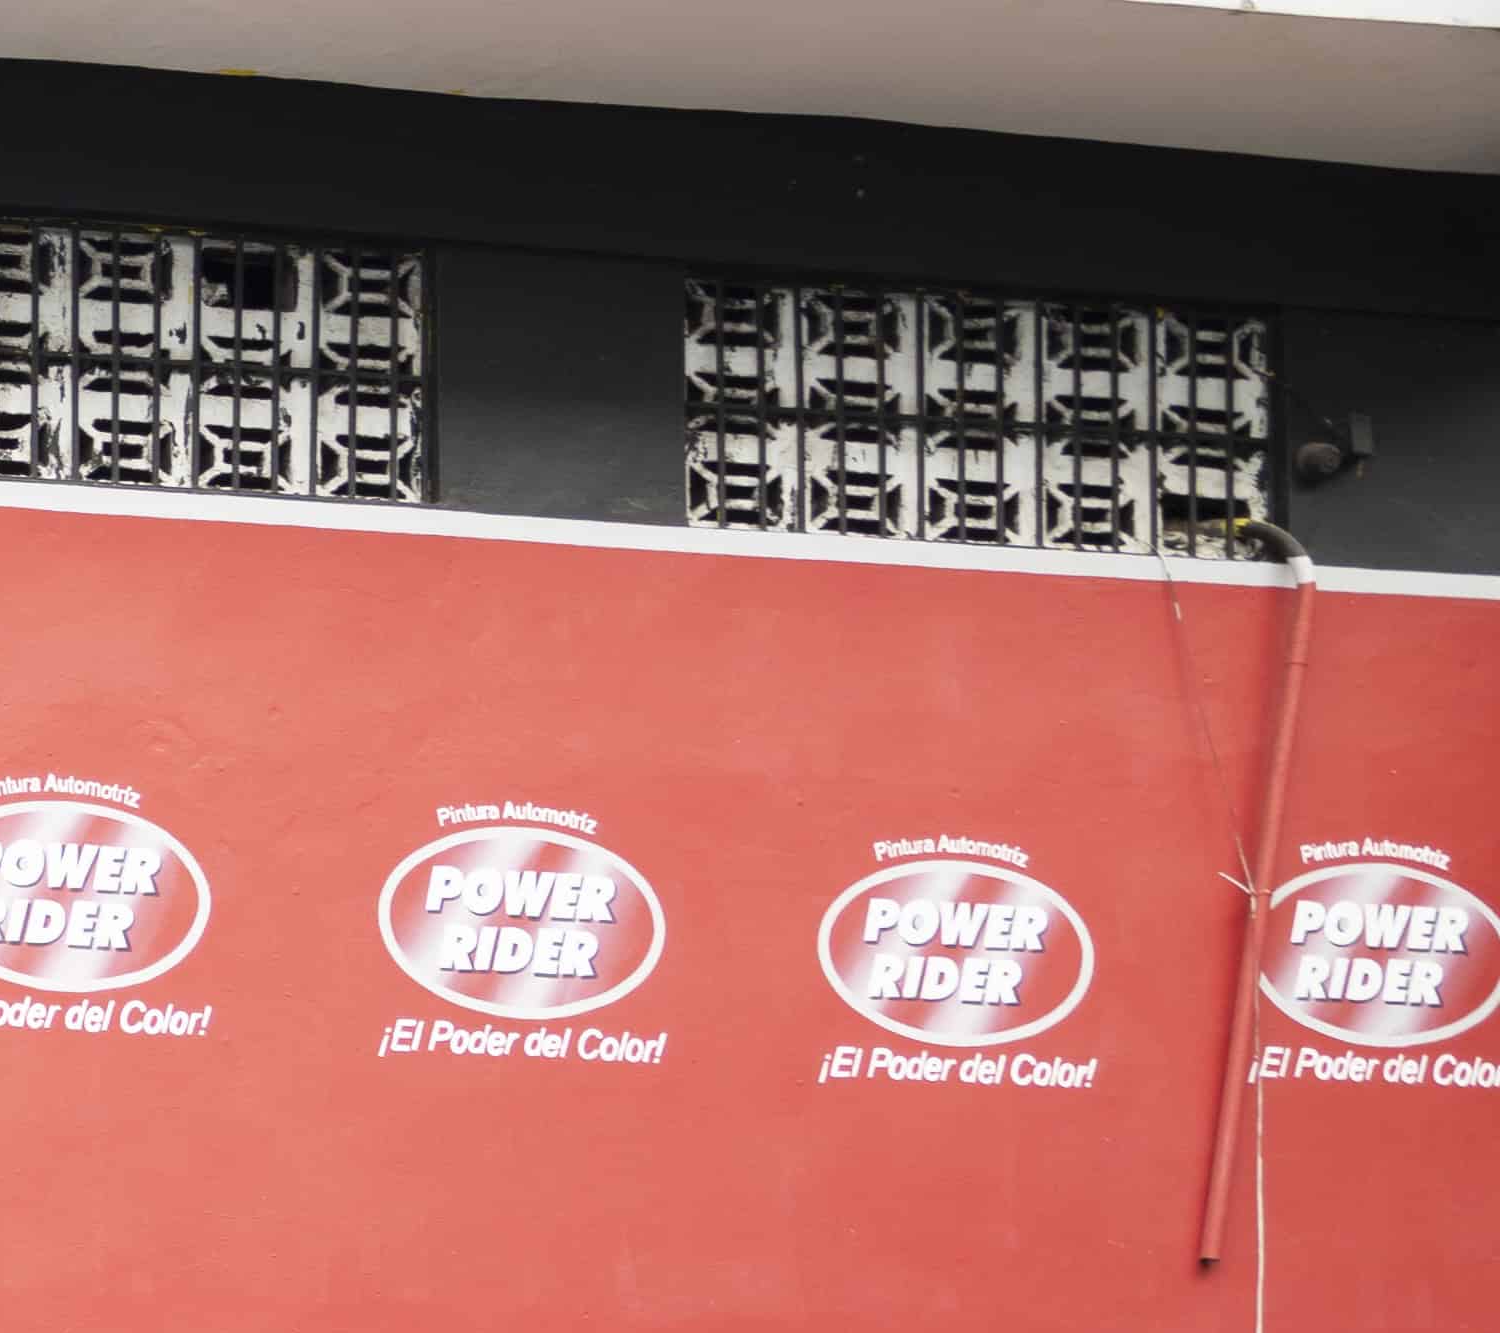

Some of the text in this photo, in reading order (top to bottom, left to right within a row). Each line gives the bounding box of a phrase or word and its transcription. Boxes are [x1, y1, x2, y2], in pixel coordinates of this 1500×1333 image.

[436, 803, 500, 826] Pintura
[872, 837, 935, 861] Pintura
[1299, 841, 1360, 865] Pintura
[424, 865, 617, 923] POWER
[863, 897, 1049, 953] POWER
[1290, 900, 1469, 956] POWER
[439, 924, 599, 980] RIDER
[869, 953, 1022, 1007] RIDER
[1295, 955, 1444, 1008] RIDER
[64, 999, 116, 1032] del
[119, 1000, 212, 1035] Color!
[377, 1018, 668, 1064] ¡El Poder del Color!
[817, 1045, 1098, 1088] ¡El Poder del Color!
[1247, 1046, 1292, 1084] ¡El
[1294, 1047, 1379, 1082] Poder
[1383, 1053, 1428, 1084] del
